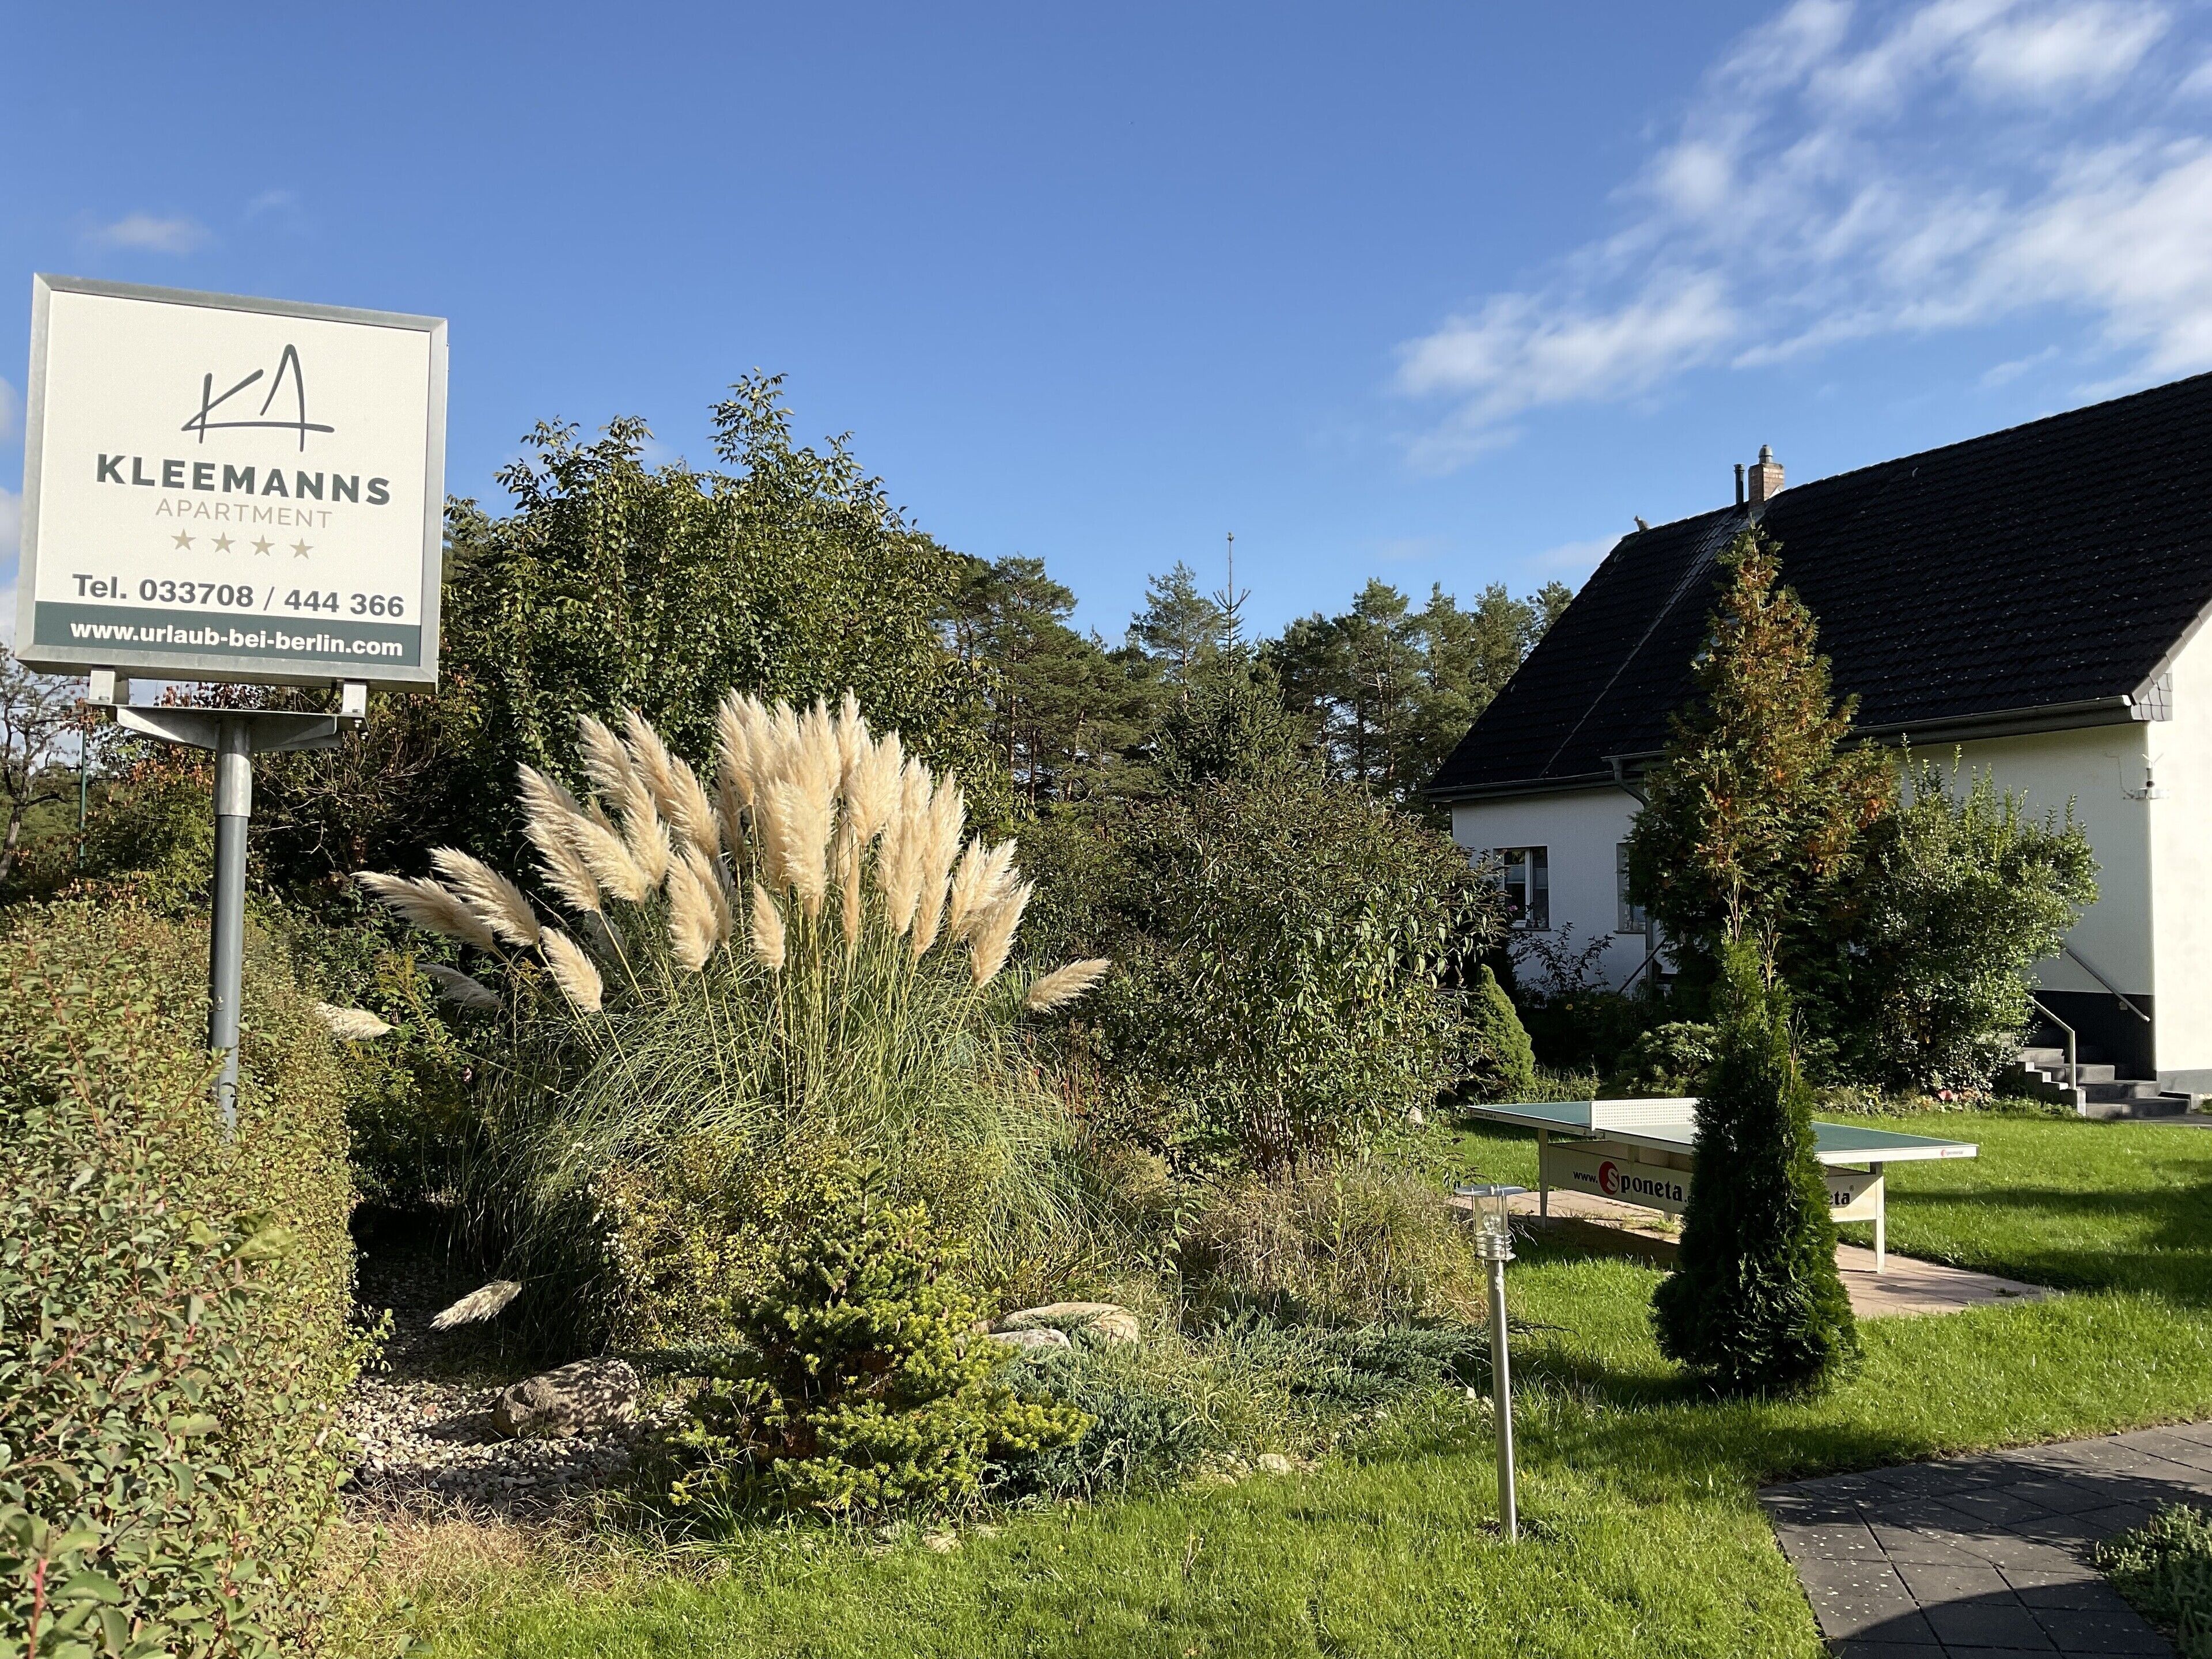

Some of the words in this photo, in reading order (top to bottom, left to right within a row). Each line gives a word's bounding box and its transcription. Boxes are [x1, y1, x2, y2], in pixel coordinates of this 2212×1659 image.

[97, 454, 391, 505] KLEEMANNS
[155, 498, 334, 529] APARTMENT
[73, 574, 127, 599] Tel.
[139, 579, 253, 607] 033708
[263, 586, 275, 611] /
[284, 589, 339, 613] 444
[350, 593, 404, 618] 366
[70, 621, 403, 657] www.urlaub-bei-berlin.com
